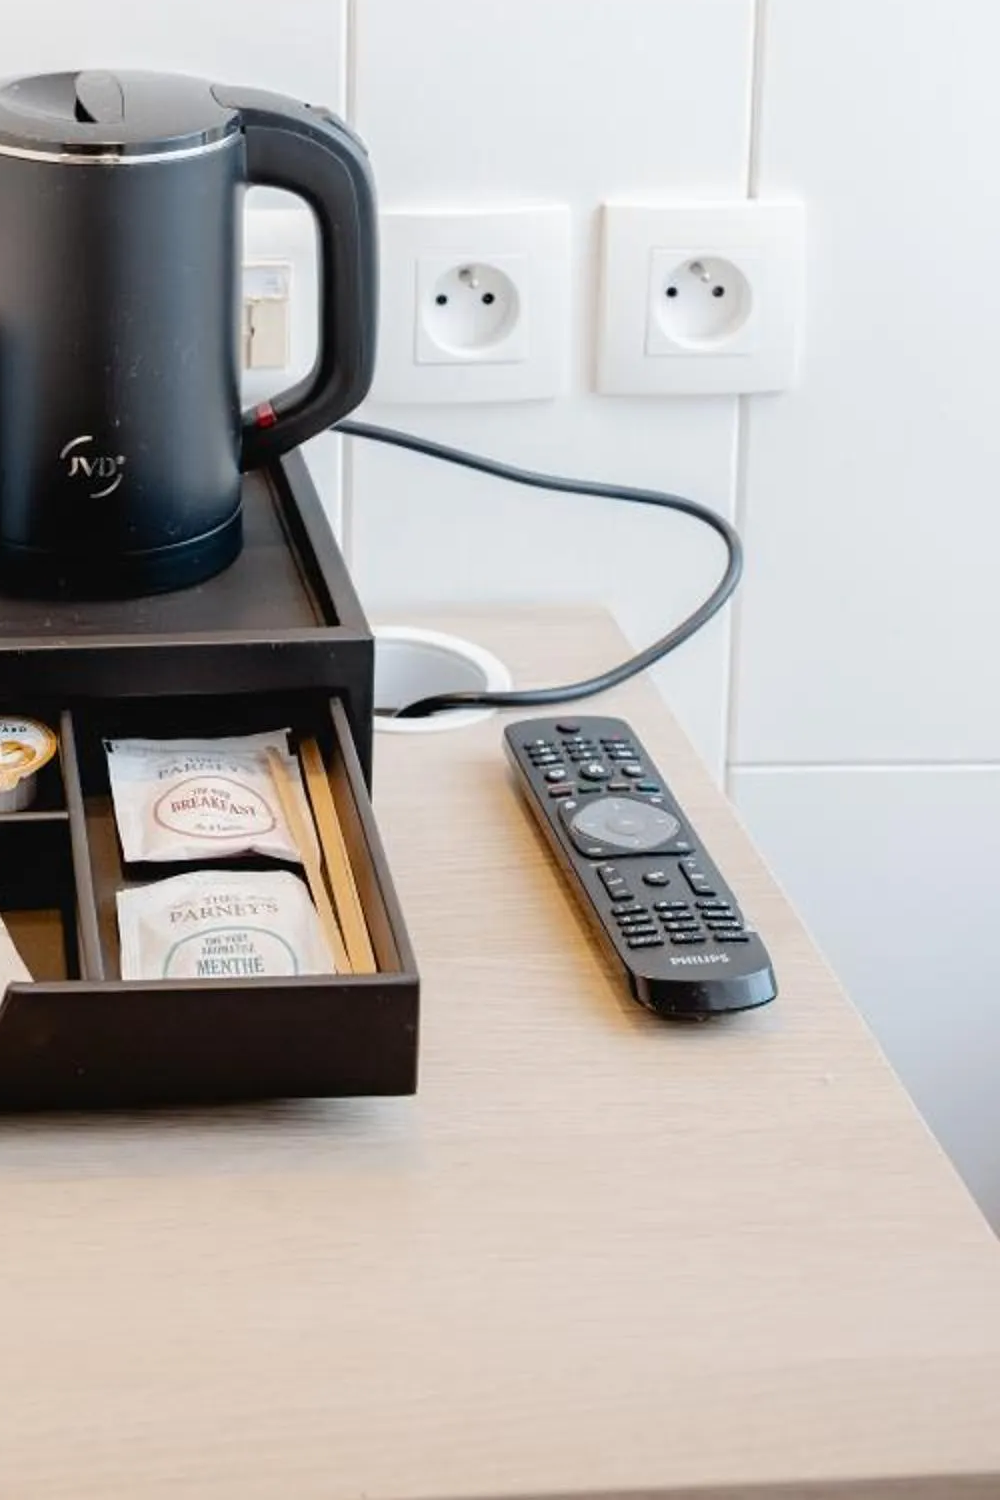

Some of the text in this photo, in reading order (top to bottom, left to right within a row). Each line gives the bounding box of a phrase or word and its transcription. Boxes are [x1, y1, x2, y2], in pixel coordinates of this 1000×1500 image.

[171, 796, 257, 817] BREAKFAST
[169, 902, 279, 923] PARNEY'S
[196, 956, 265, 977] MENTHE
